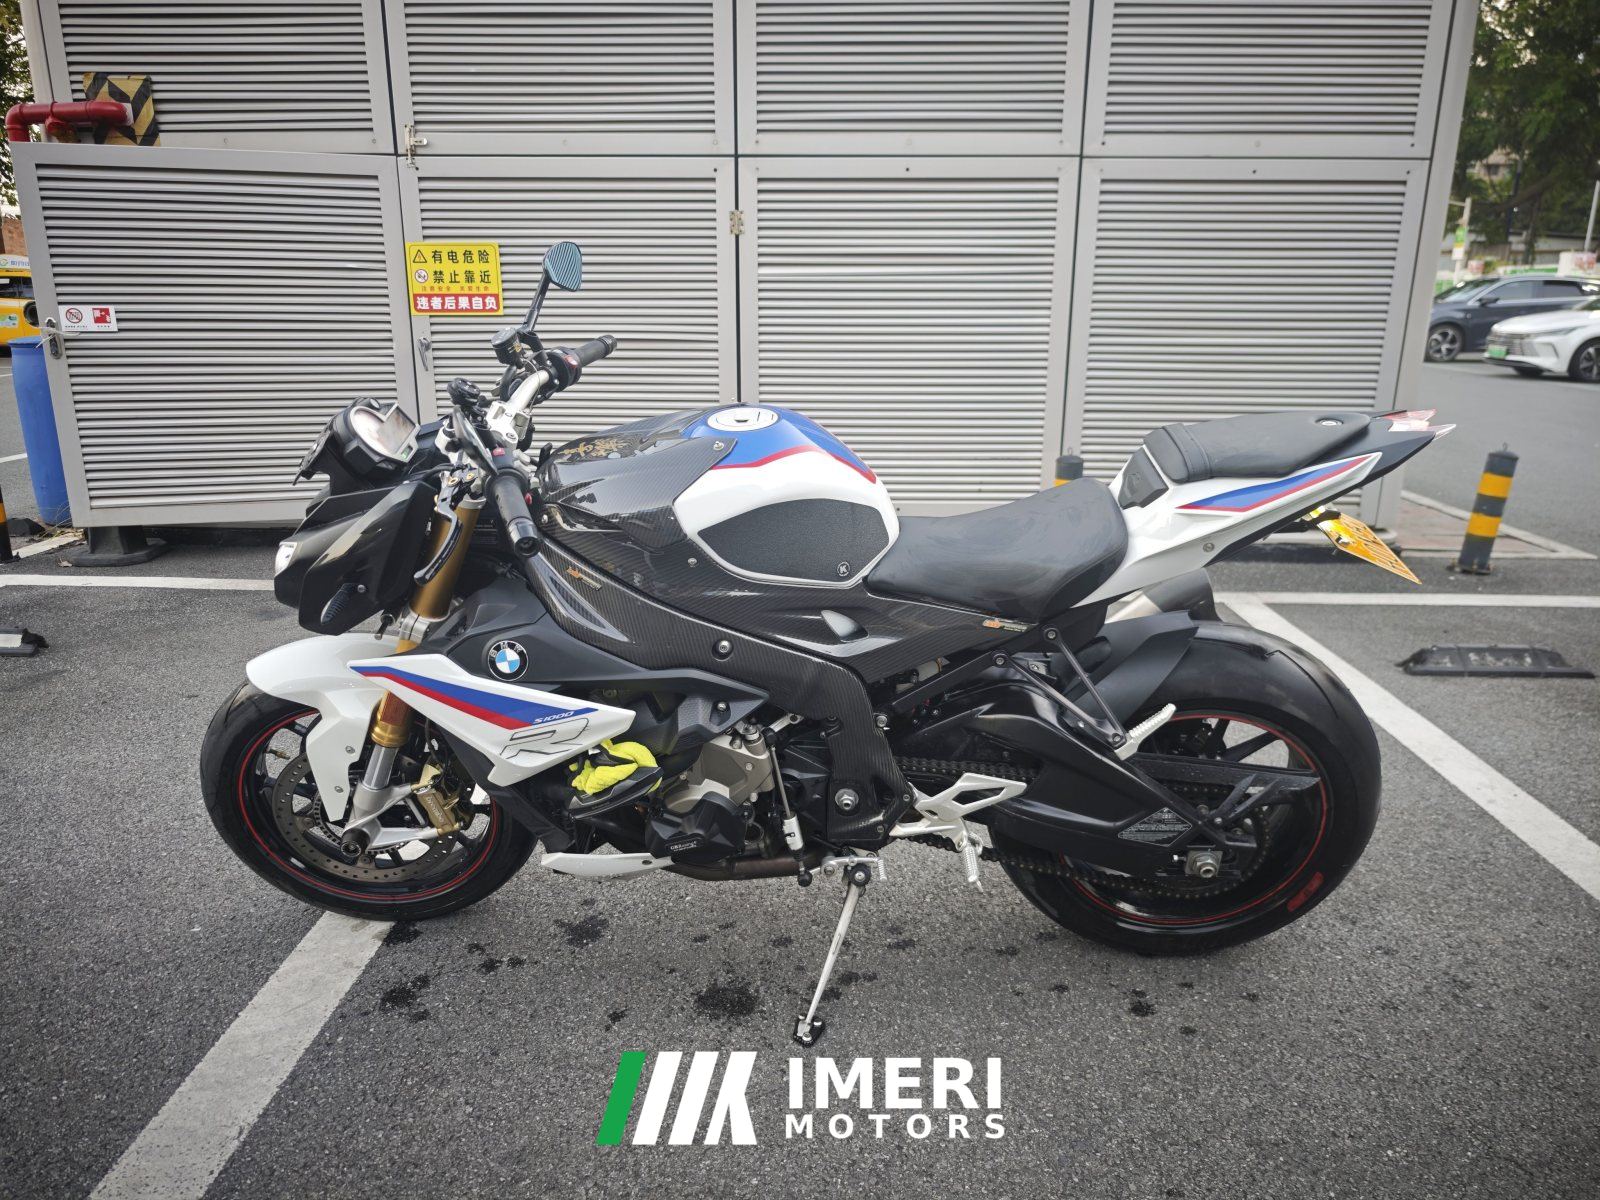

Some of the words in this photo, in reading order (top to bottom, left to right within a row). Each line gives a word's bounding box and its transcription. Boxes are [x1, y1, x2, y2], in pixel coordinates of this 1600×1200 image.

[432, 250, 490, 264] 有电危险
[433, 270, 492, 284] 禁止靠近
[416, 296, 498, 310] 违者后果自负
[489, 640, 524, 658] BMW
[533, 710, 576, 725] S1000
